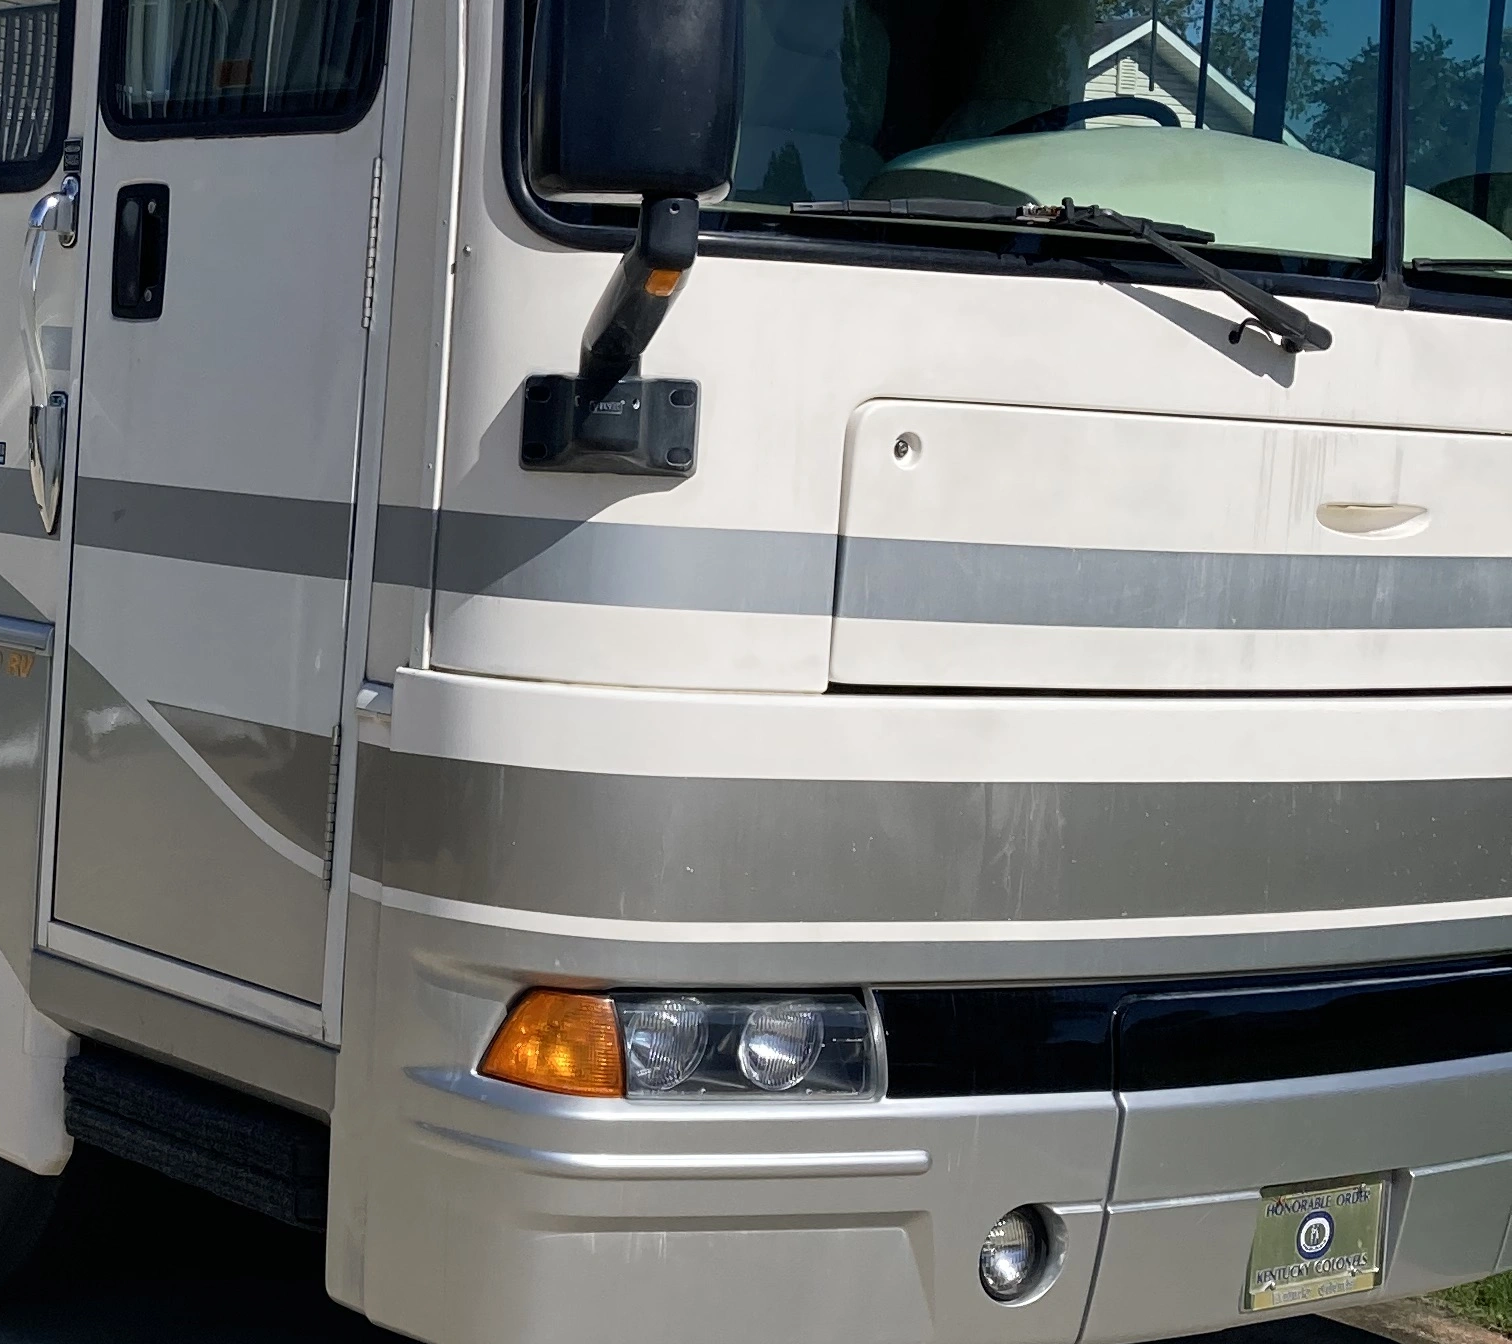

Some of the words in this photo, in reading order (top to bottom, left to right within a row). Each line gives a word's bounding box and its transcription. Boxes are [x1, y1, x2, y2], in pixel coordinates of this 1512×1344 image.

[7, 651, 35, 678] RV
[1265, 1196, 1332, 1218] HONORABLE
[1336, 1189, 1371, 1206] ORDER
[1256, 1261, 1311, 1284] KENTUCKY
[1315, 1252, 1368, 1274] COLONELS
